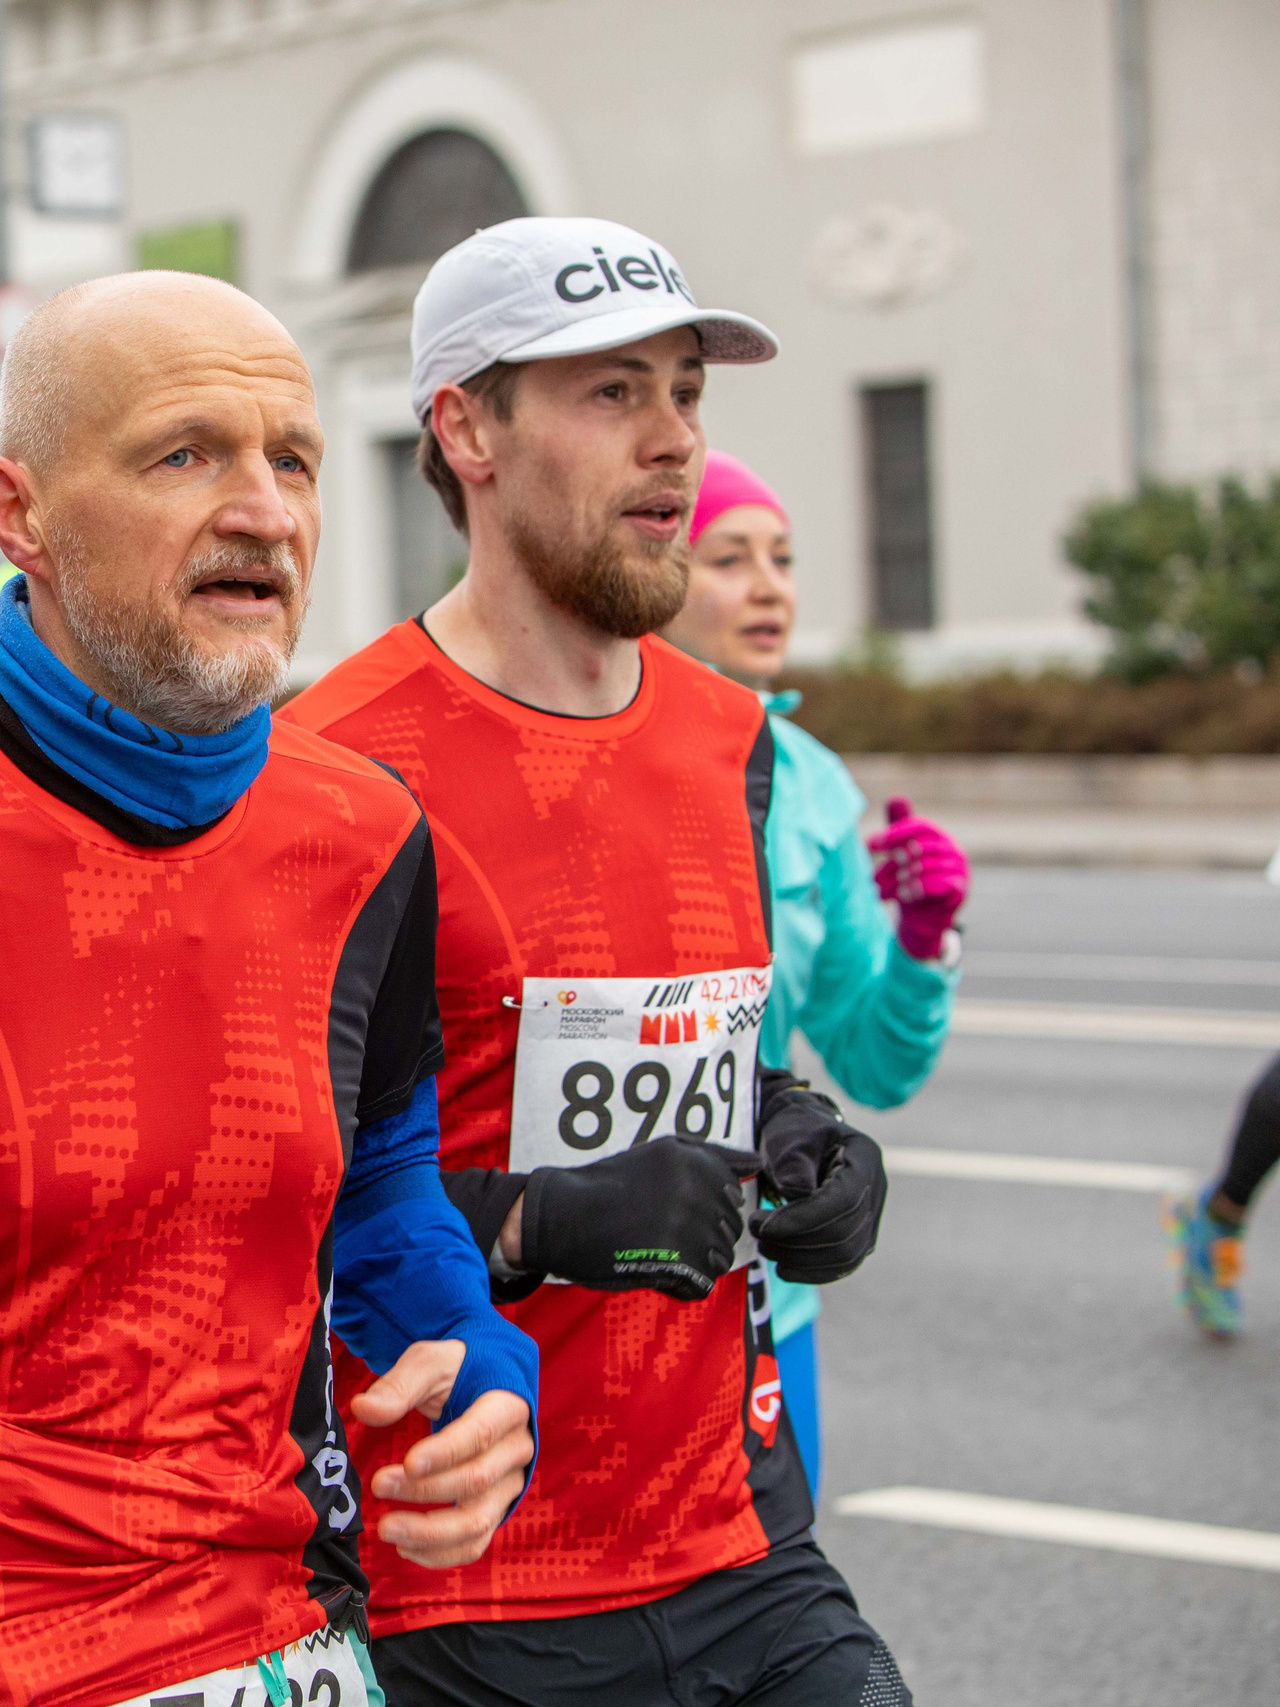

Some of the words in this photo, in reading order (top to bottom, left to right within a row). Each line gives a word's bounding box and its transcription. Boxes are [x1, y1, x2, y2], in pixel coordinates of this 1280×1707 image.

[561, 1008, 624, 1016] МОСКОВСКИЙ
[560, 1016, 606, 1024] МАРАФОН
[559, 1024, 600, 1032] MOSCOW
[558, 1032, 608, 1040] MARATHON
[558, 1050, 736, 1150] 8969
[613, 1249, 680, 1261] VORTEX
